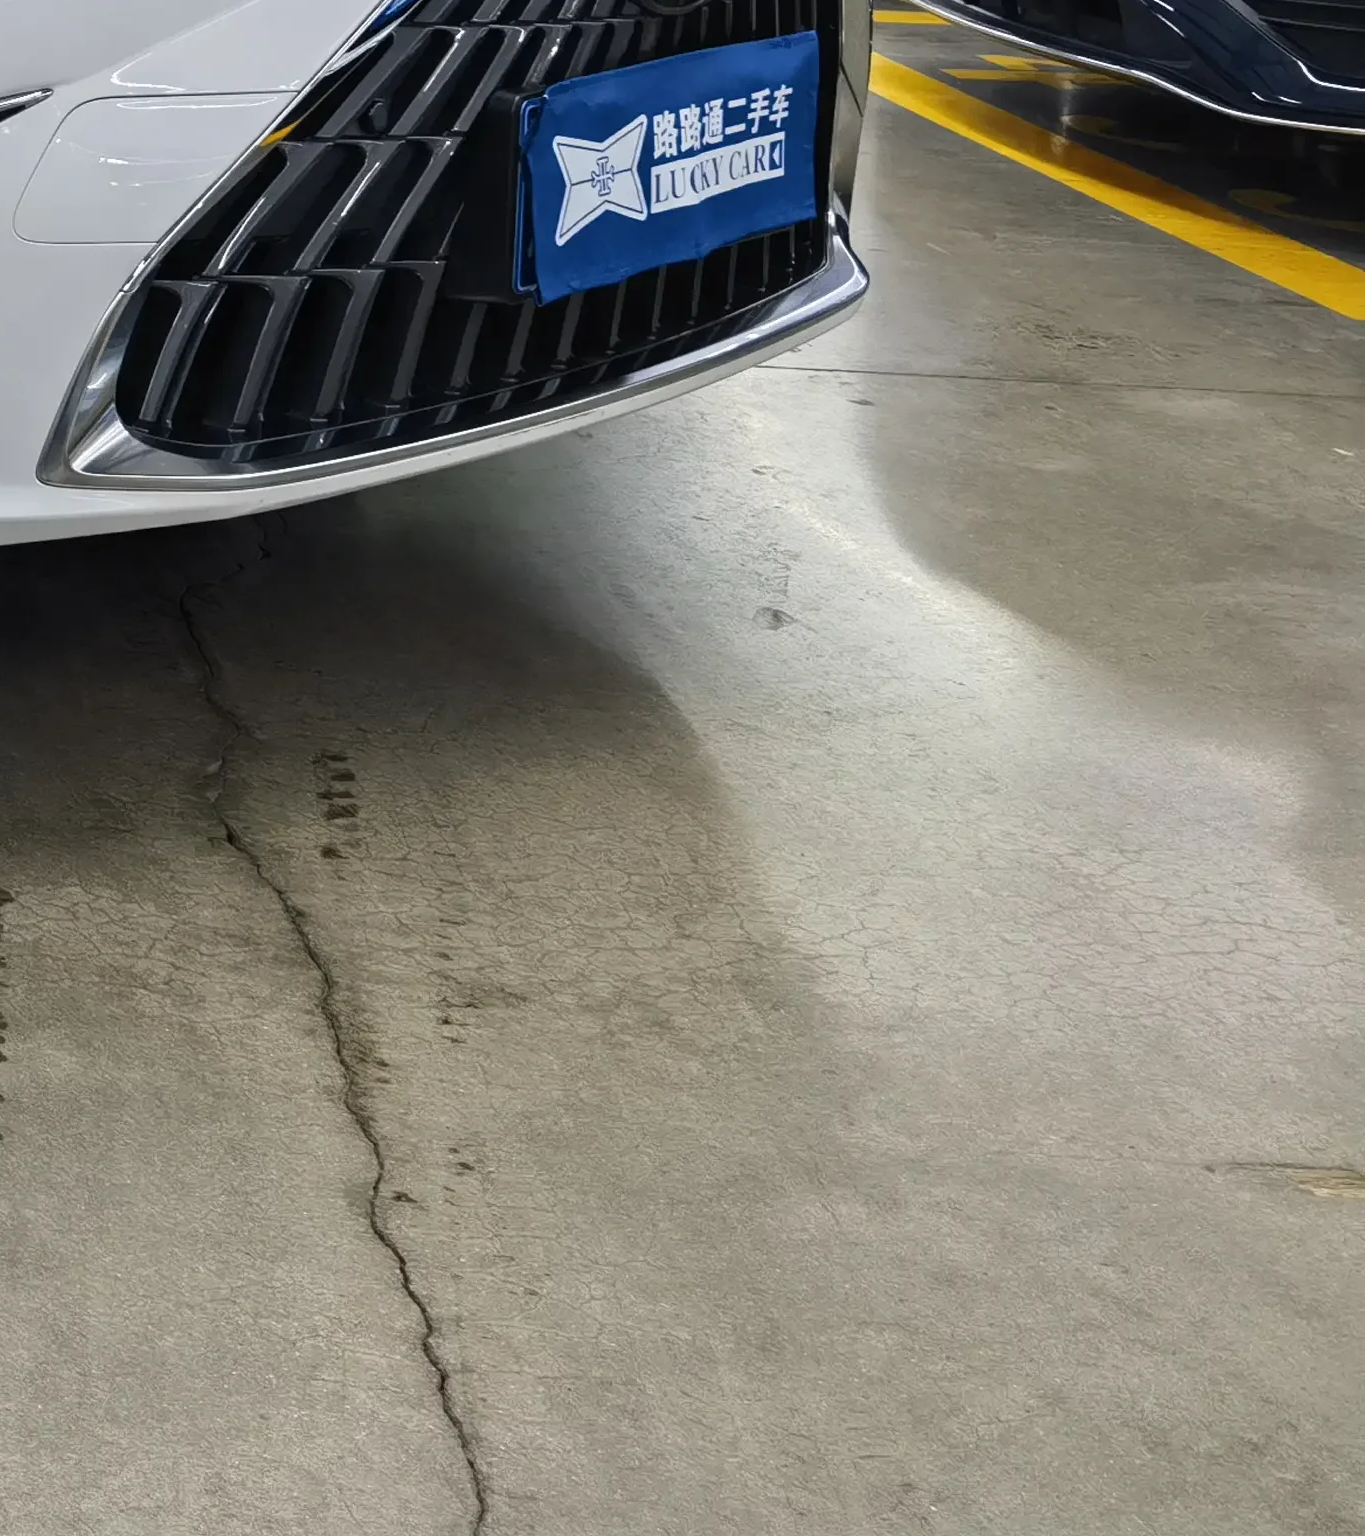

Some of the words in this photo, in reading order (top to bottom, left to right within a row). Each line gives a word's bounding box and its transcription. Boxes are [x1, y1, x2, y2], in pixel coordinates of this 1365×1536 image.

[652, 84, 794, 160] 路路通二手车
[654, 154, 724, 204] LUCKY
[728, 143, 767, 181] CAR
